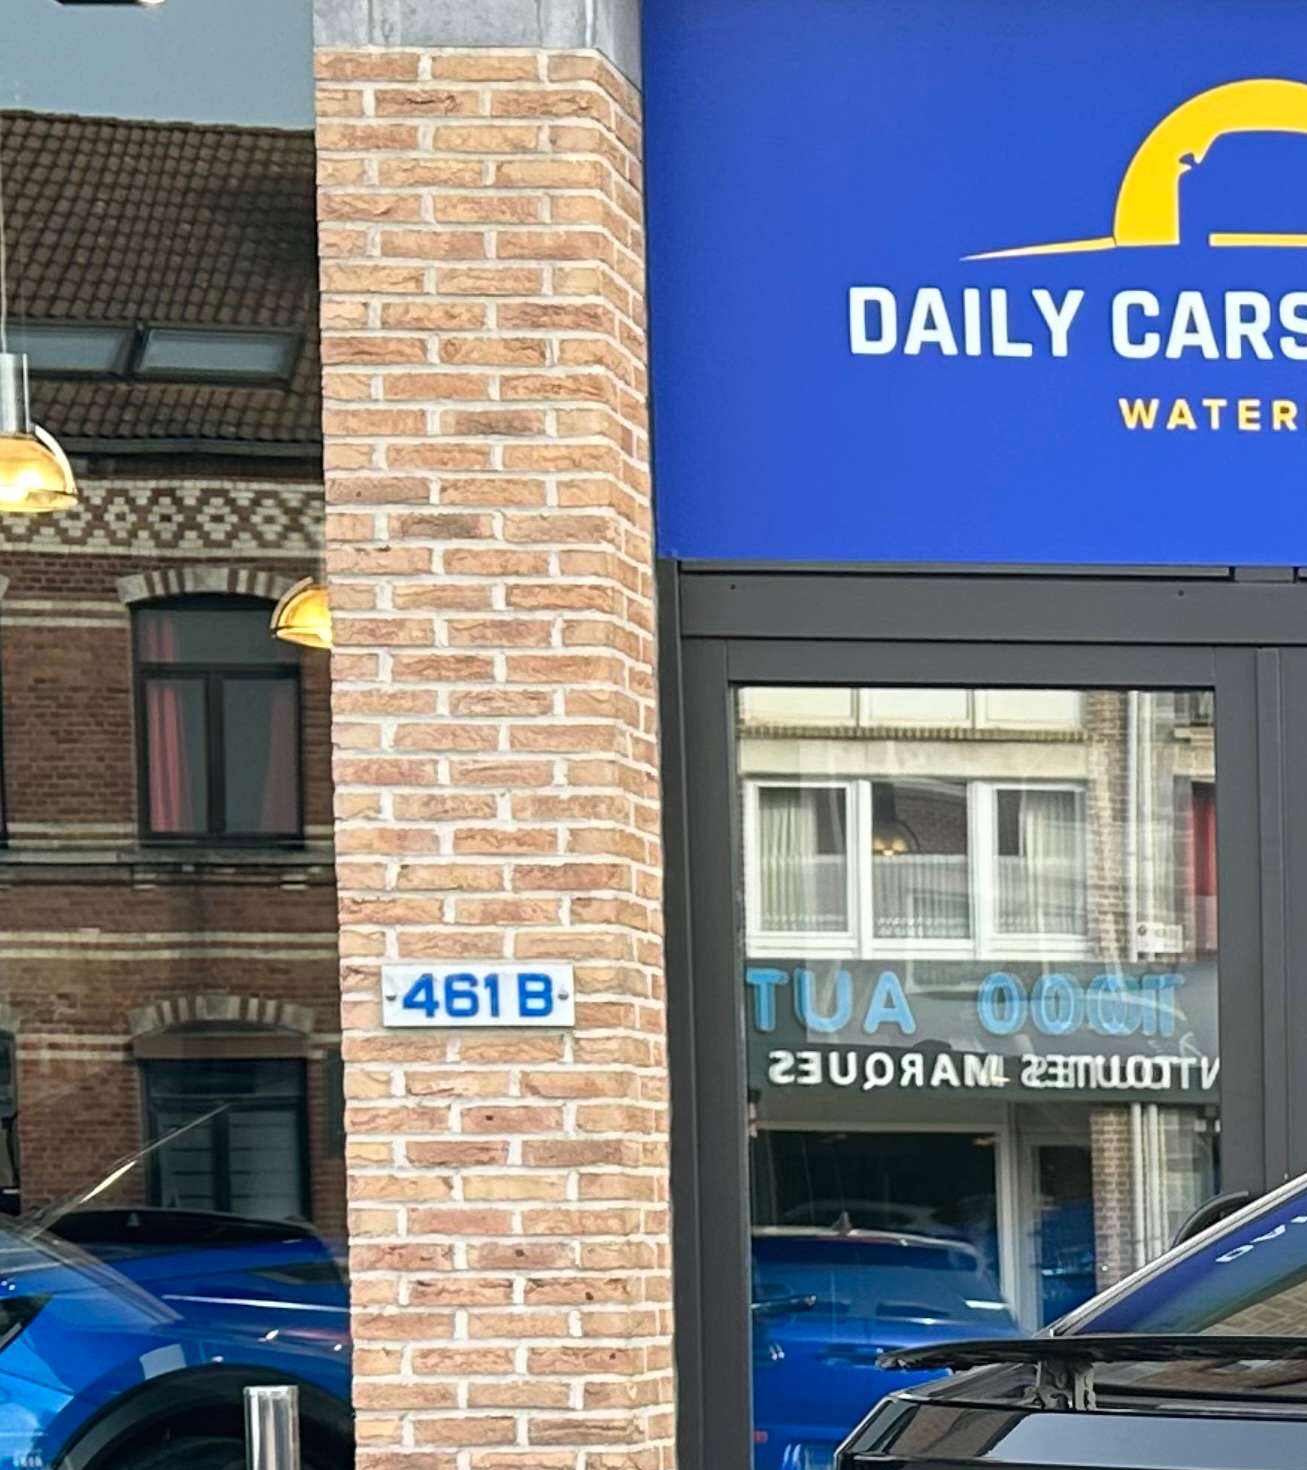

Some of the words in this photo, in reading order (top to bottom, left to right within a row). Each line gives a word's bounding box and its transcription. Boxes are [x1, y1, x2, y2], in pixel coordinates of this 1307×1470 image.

[849, 287, 1085, 358] DAILY
[402, 973, 500, 1018] 461
[517, 973, 554, 1018] B
